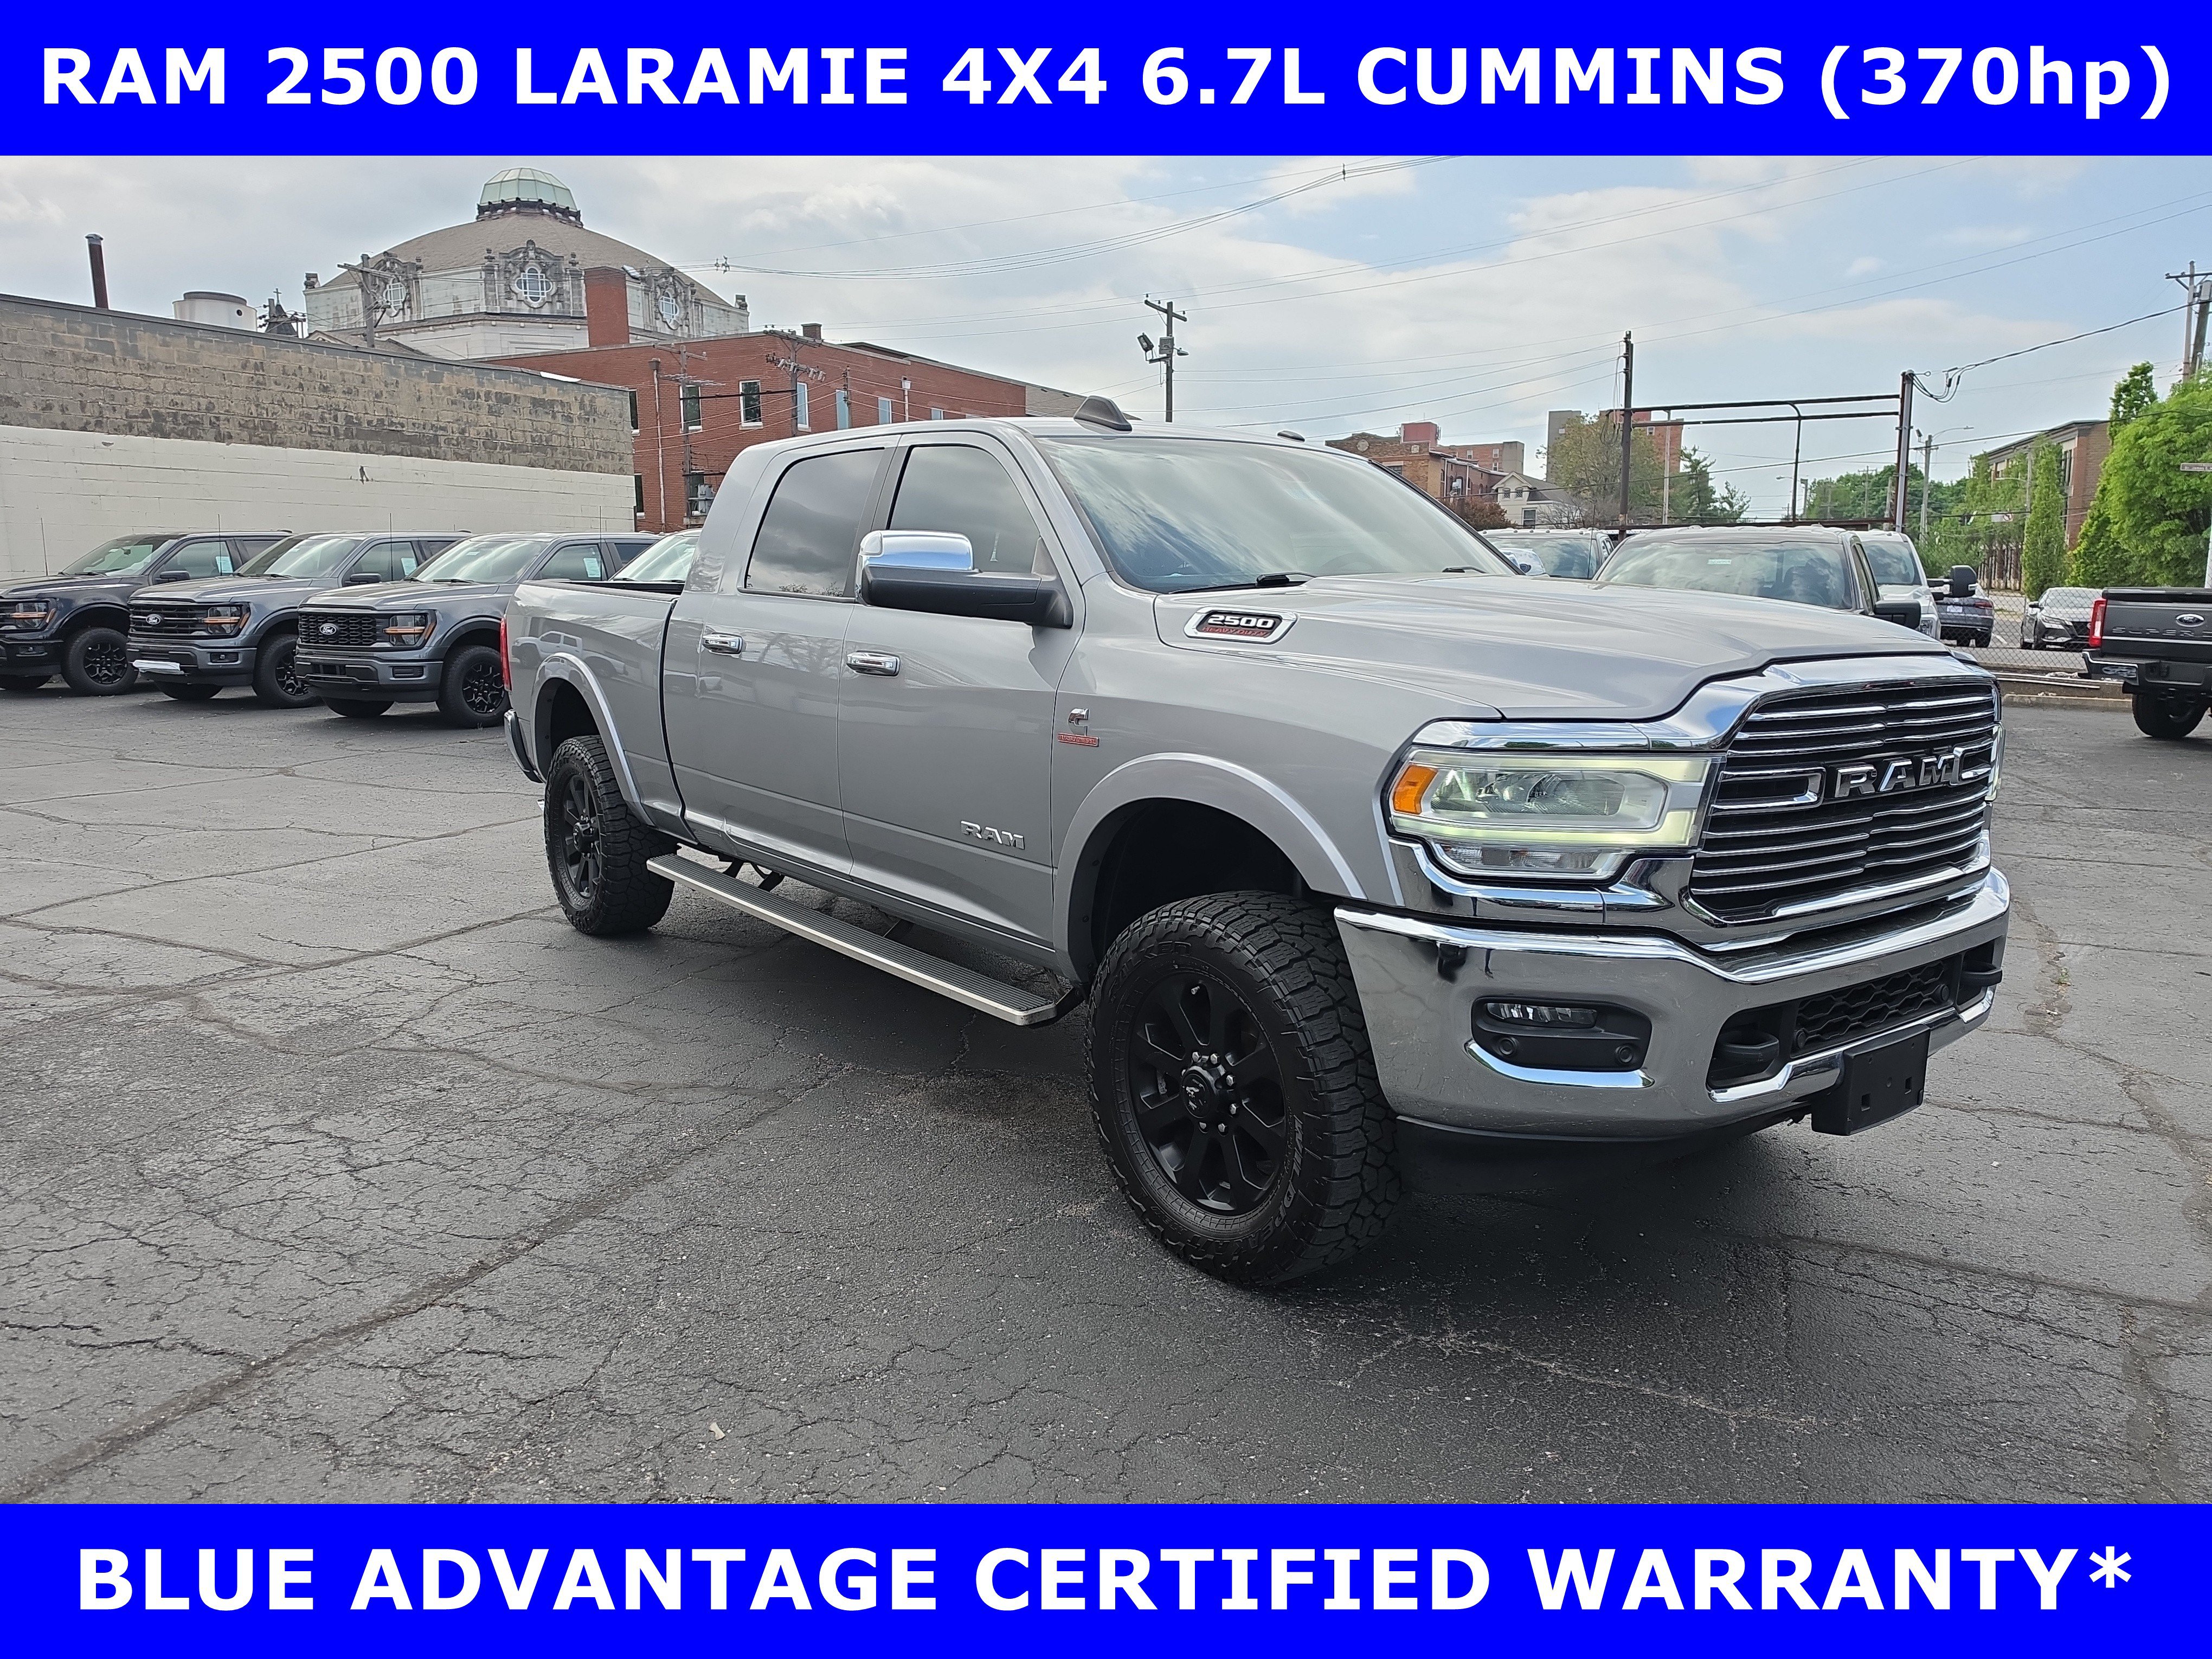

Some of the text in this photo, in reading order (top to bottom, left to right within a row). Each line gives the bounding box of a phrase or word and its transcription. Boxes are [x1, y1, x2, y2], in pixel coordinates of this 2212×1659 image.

[1207, 614, 1275, 629] 2500
[2112, 626, 2195, 638] SUPER
[1834, 754, 1956, 798] RAM
[961, 820, 1025, 850] RAM
